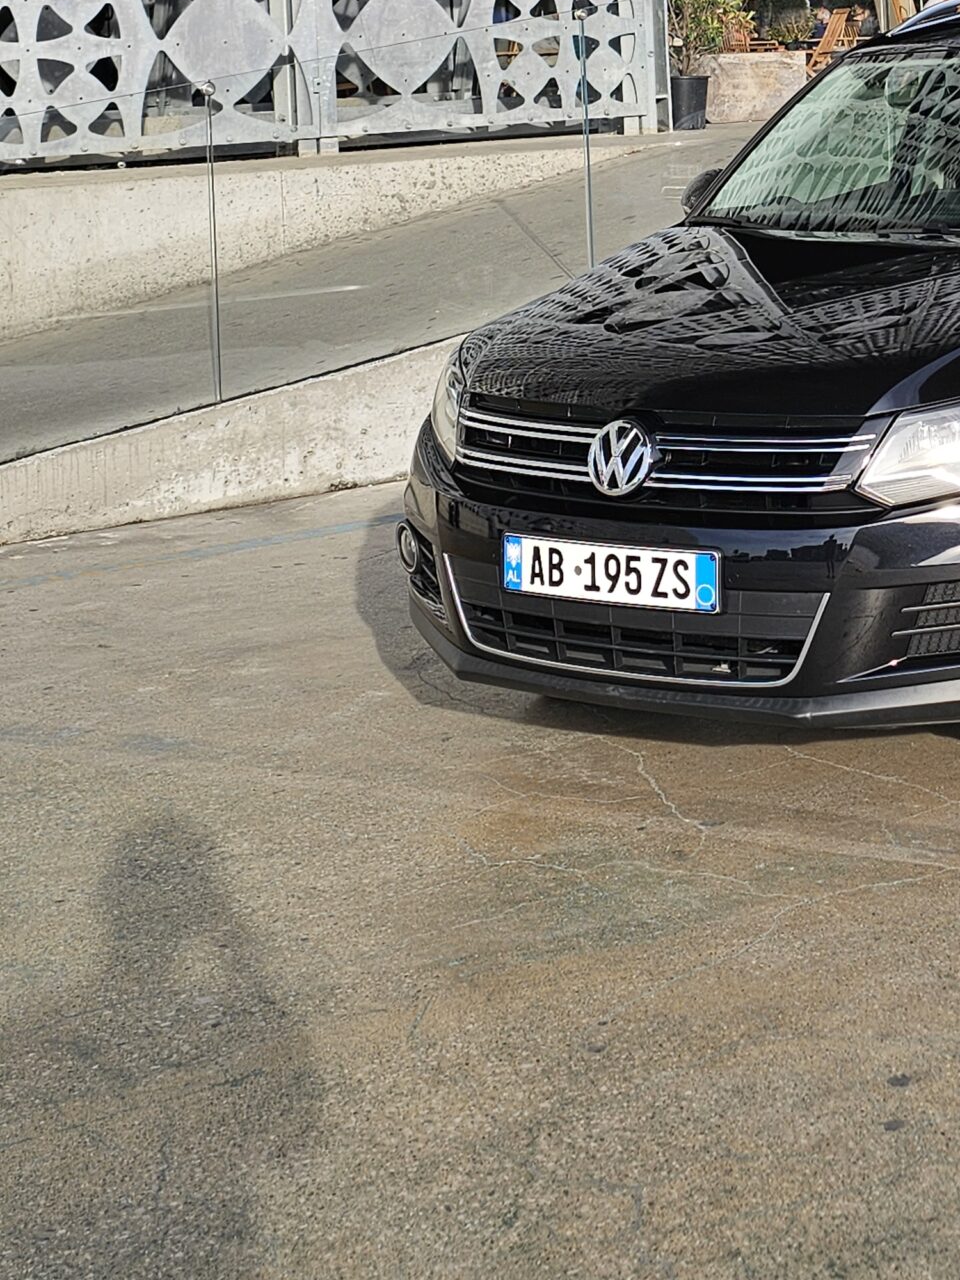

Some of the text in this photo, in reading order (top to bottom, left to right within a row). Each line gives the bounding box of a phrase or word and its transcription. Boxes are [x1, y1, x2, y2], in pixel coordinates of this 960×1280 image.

[506, 570, 521, 583] AL
[529, 546, 691, 600] AB 195 ZS
